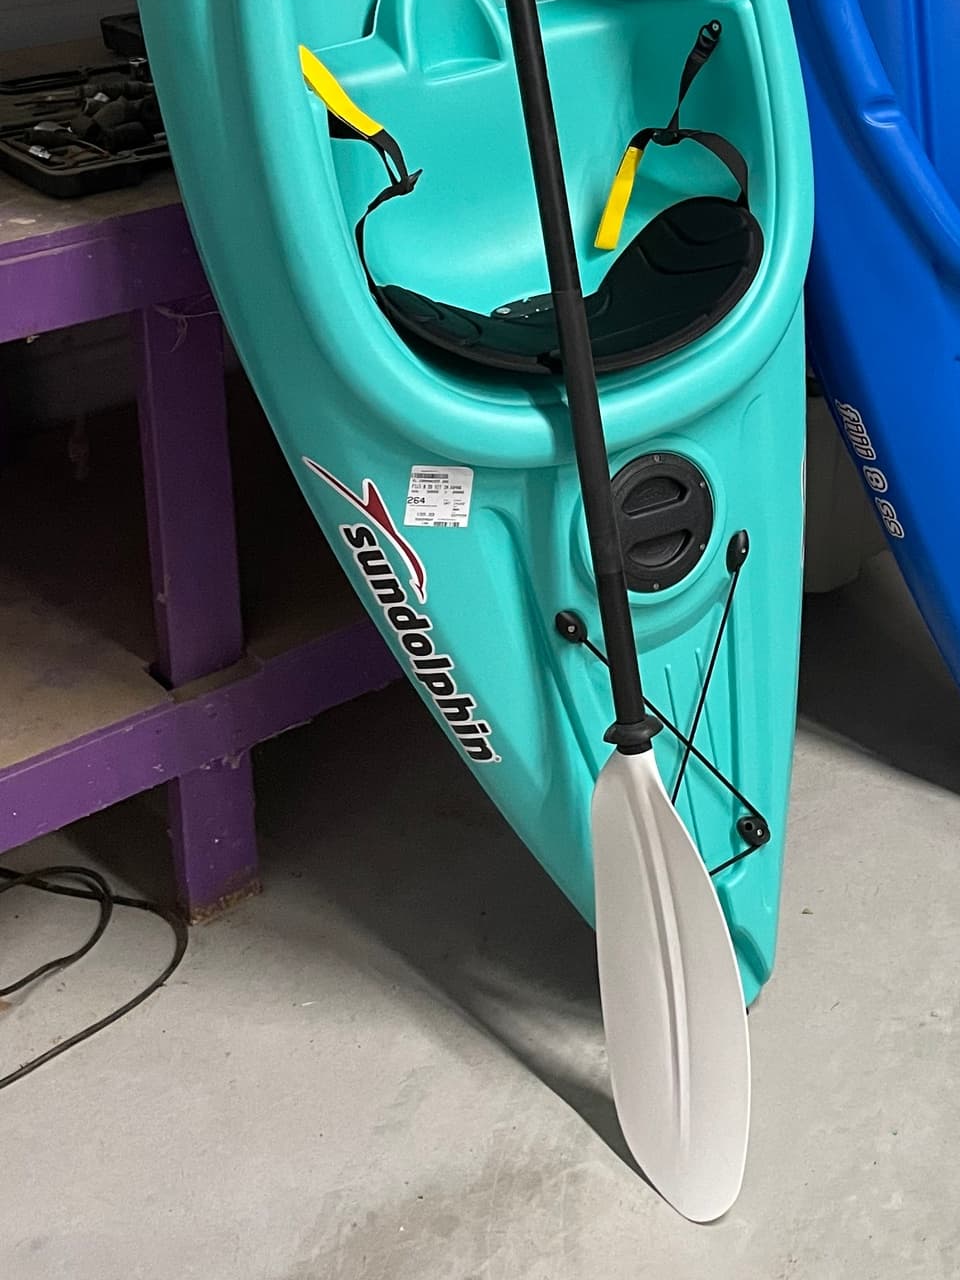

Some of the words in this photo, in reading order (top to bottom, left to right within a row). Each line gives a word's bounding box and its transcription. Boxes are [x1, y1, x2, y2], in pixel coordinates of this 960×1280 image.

[863, 465, 888, 493] 8
[407, 496, 426, 505] 264
[338, 523, 497, 763] sundolphin
